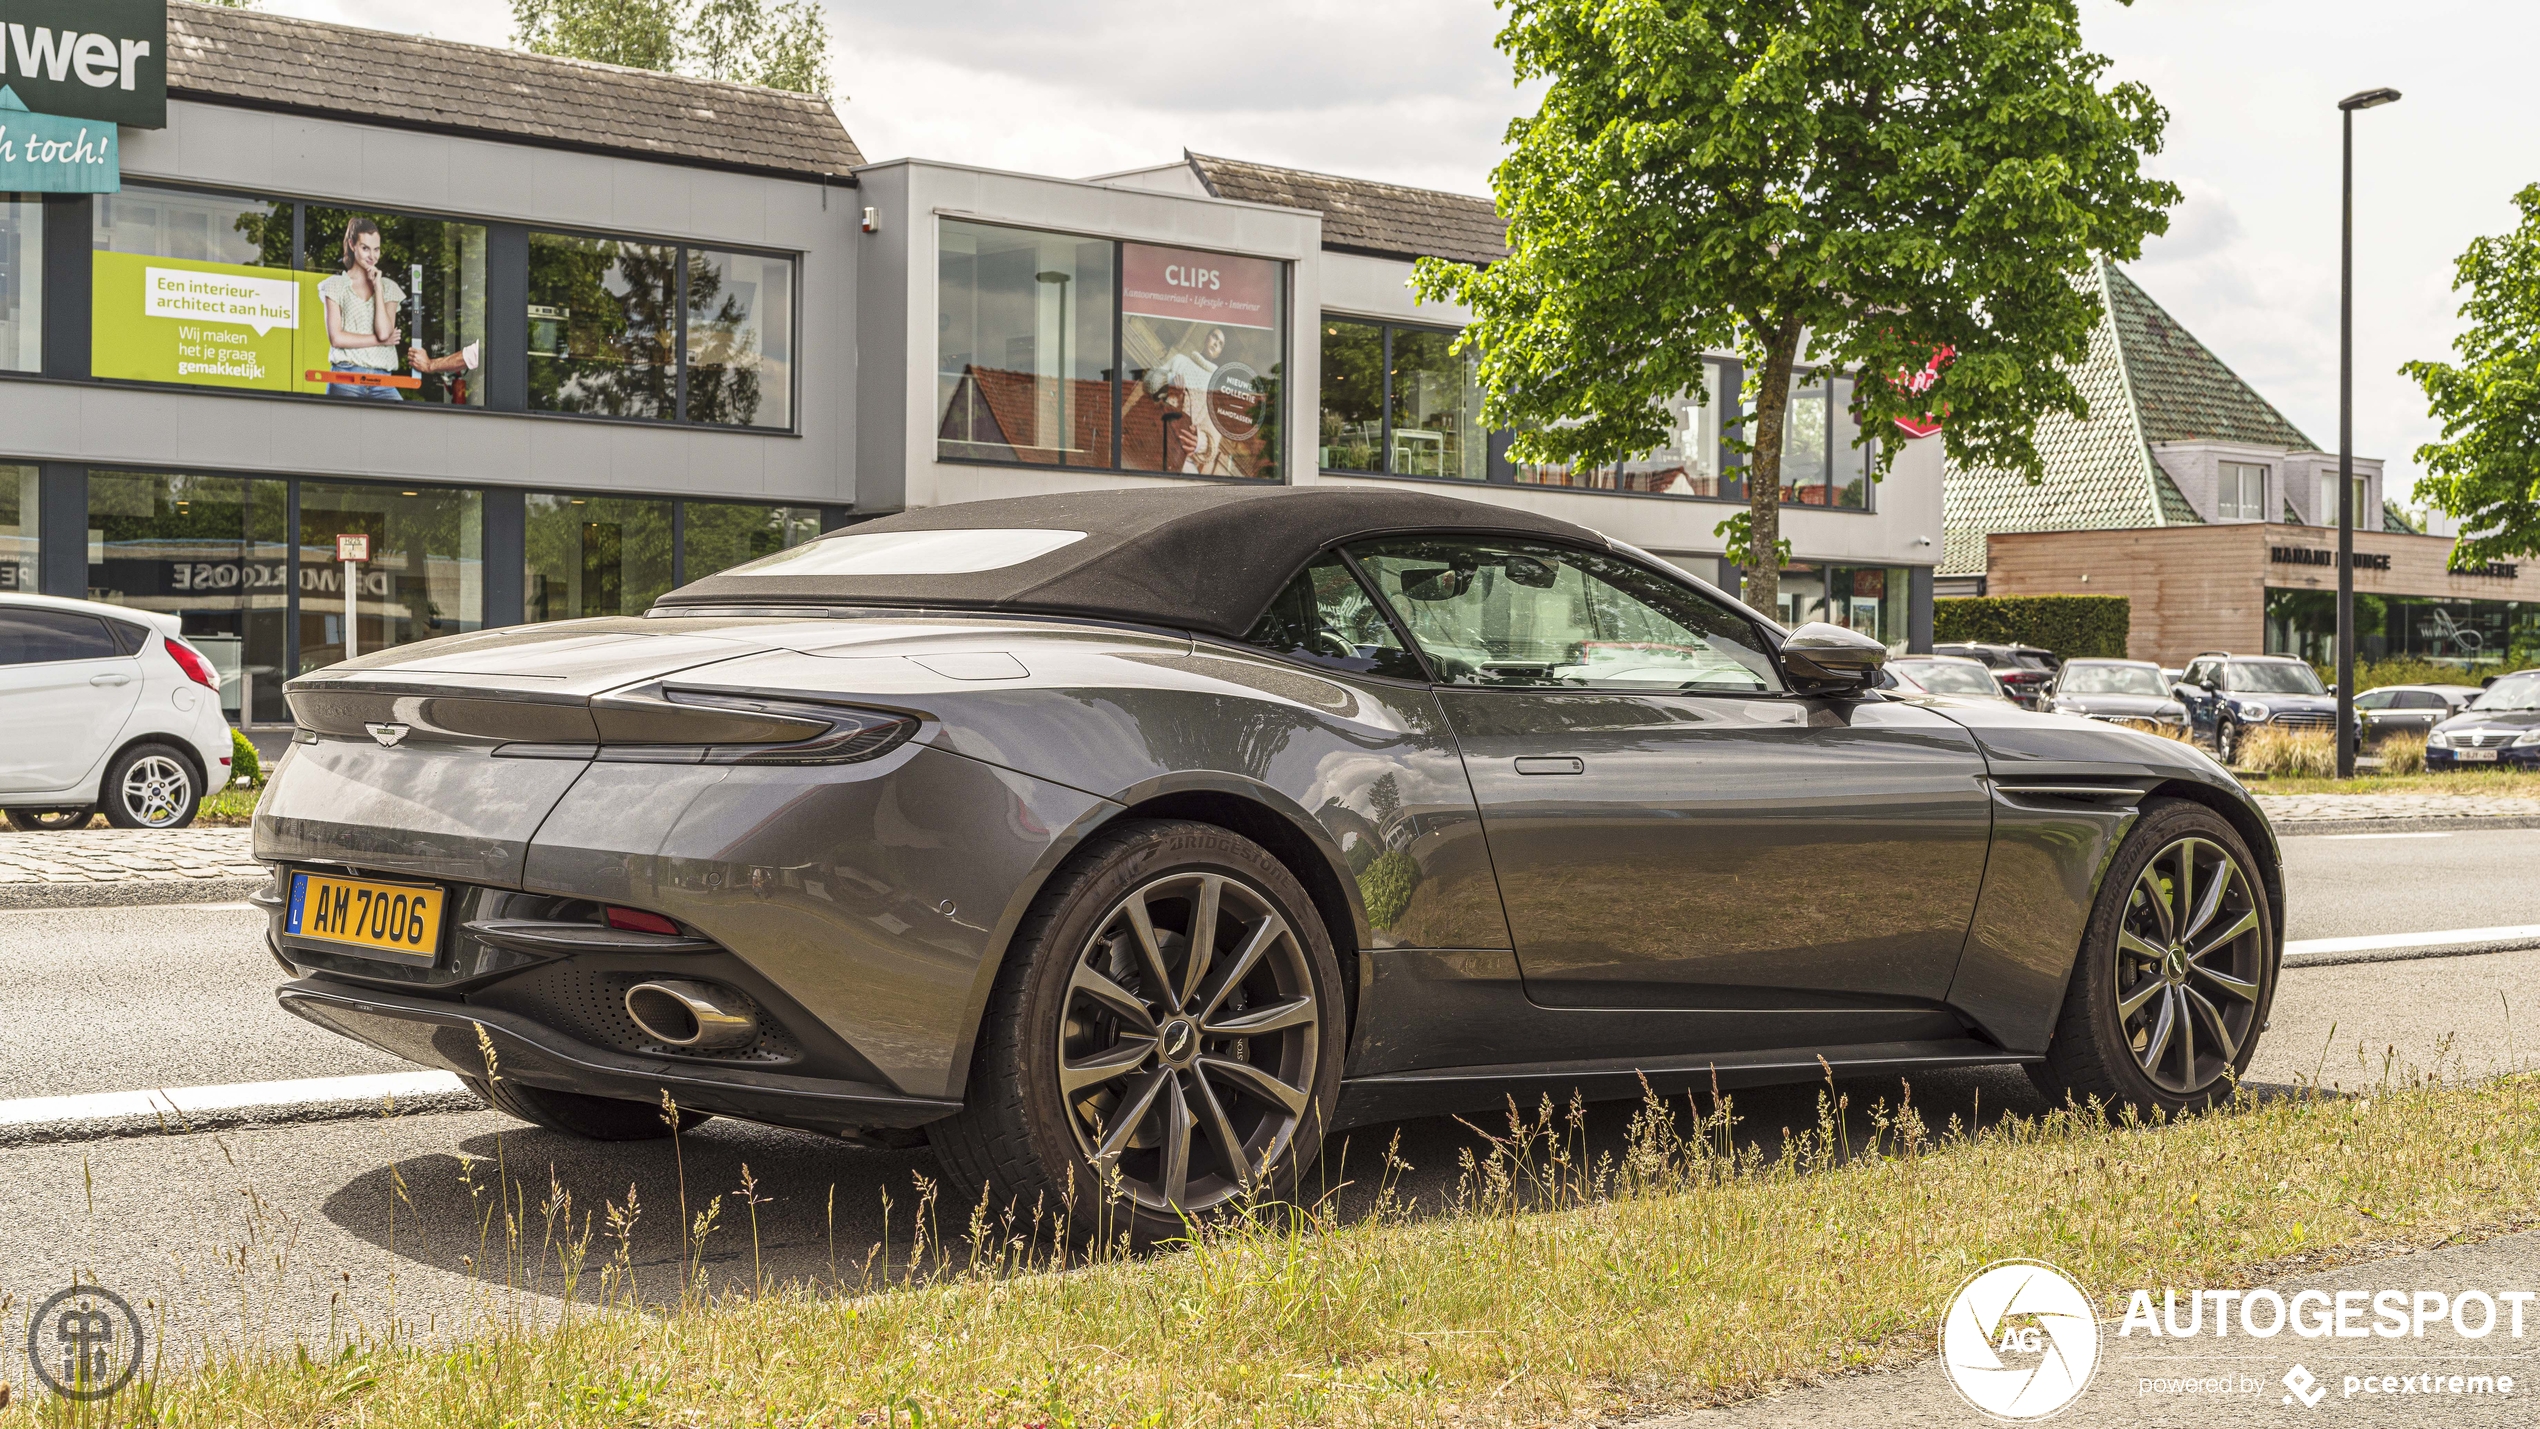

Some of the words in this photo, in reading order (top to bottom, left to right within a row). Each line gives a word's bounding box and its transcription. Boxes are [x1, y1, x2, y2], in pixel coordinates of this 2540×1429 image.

[25, 127, 108, 164] toch!
[157, 277, 185, 292] Een
[189, 280, 260, 298] interieur-
[1165, 265, 1220, 290] CLIPS
[157, 297, 225, 313] architect
[229, 304, 256, 316] aan
[260, 305, 291, 319] huis
[1123, 287, 1188, 304] Kantoormateriaal
[1194, 296, 1223, 309] Lifestyle
[1229, 300, 1260, 311] Interieur
[178, 326, 200, 342] Wij
[203, 330, 247, 344] maken
[178, 343, 200, 357] het
[203, 345, 215, 360] je
[218, 349, 256, 364] graag
[178, 361, 265, 380] gemakkelijk!
[1227, 376, 1253, 391] NIEUWE
[1220, 385, 1256, 404] COLLECTIE
[1217, 407, 1253, 425] HANDTASSEN
[2271, 547, 2331, 566] HANAMI
[1169, 835, 1294, 889] BRIDGESTONE
[292, 909, 298, 925] L
[314, 885, 351, 935] AM
[355, 889, 427, 945] 7006
